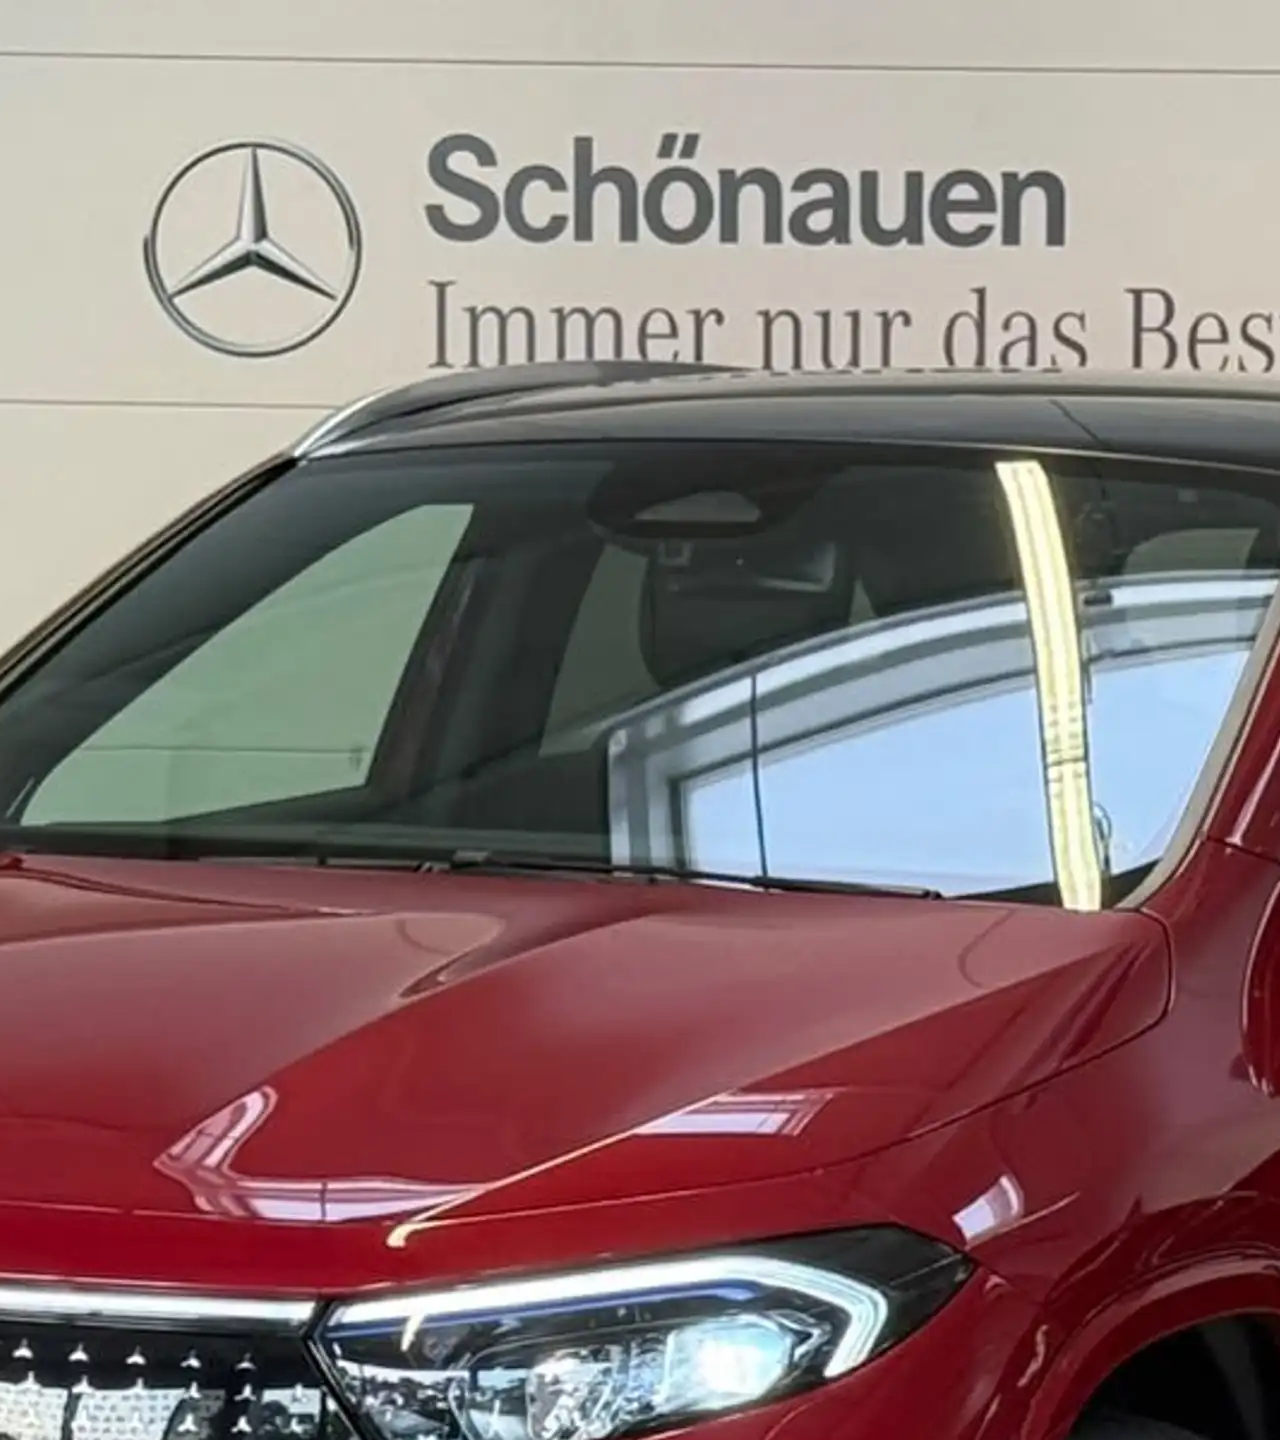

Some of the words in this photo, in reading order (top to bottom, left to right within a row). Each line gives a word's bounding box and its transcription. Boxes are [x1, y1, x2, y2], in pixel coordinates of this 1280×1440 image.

[424, 132, 1067, 247] Schönauen
[426, 280, 724, 368] Immer
[756, 306, 912, 370] nur
[943, 286, 1088, 371] das
